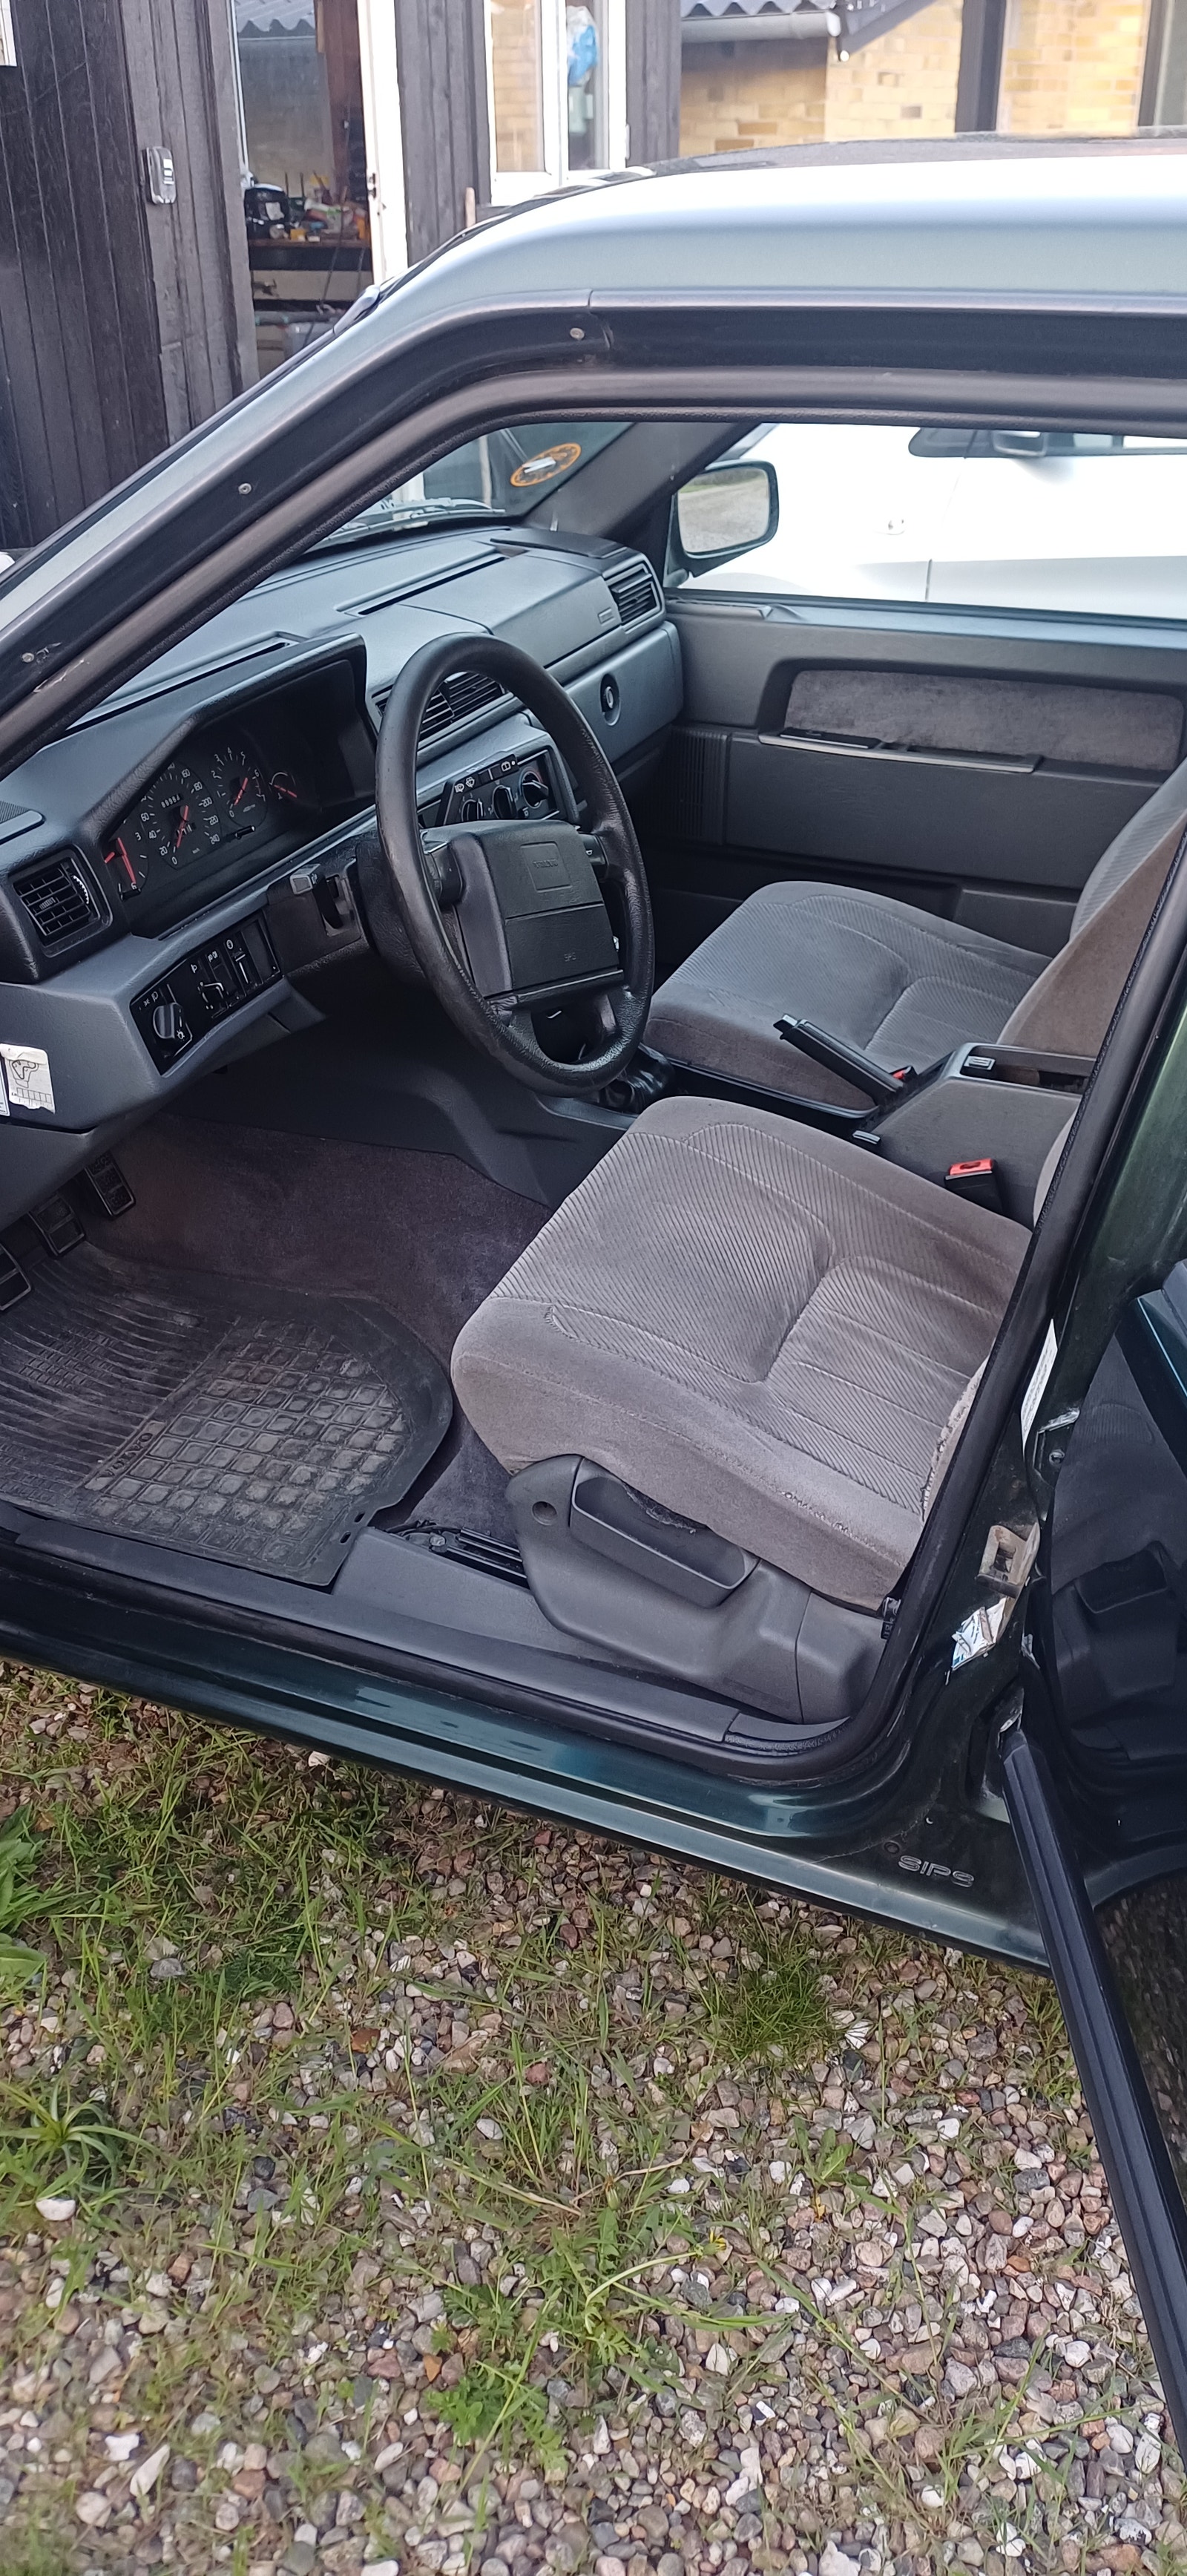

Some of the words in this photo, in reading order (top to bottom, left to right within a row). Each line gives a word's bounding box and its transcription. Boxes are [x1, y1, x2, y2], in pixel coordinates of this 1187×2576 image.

[254, 769, 260, 777] 6
[140, 812, 150, 822] 60
[228, 810, 234, 818] 0
[134, 832, 142, 841] 3
[148, 830, 157, 839] 40
[159, 847, 168, 856] 20
[171, 856, 178, 865] 0
[96, 1432, 153, 1480] VOLVO
[898, 1855, 975, 1888] SIPS
